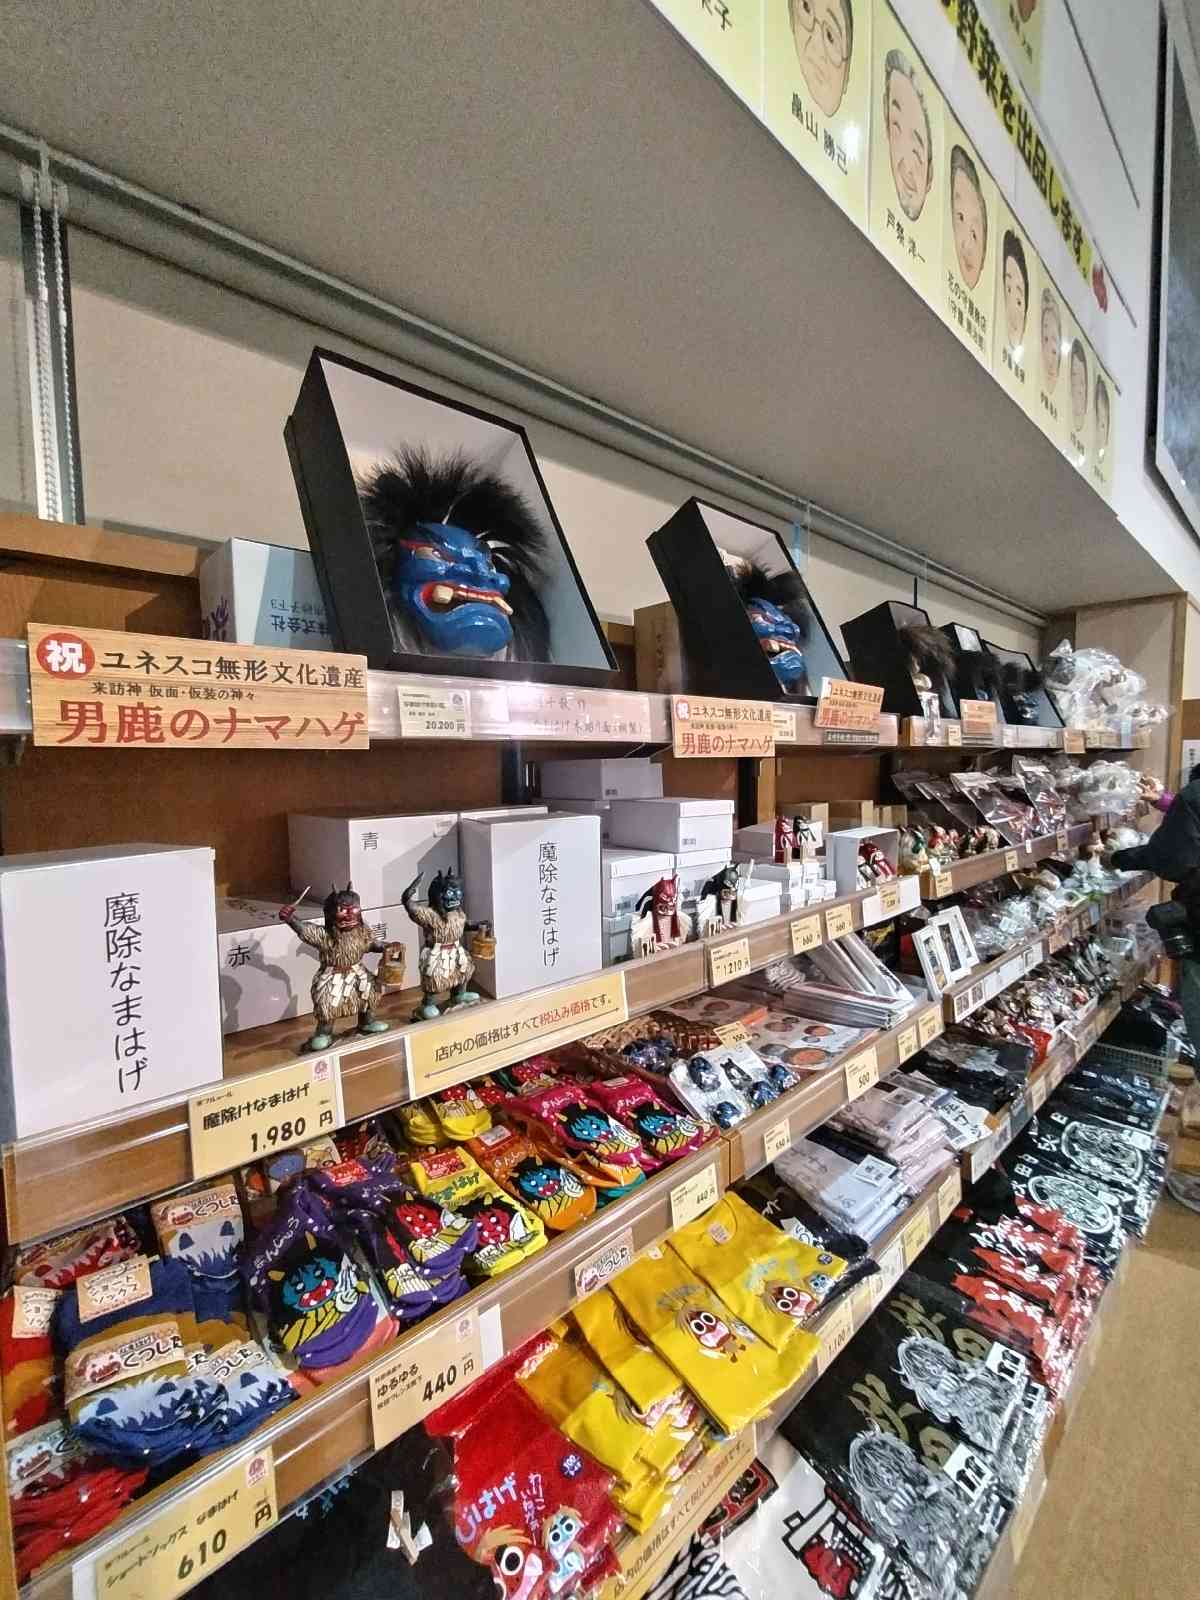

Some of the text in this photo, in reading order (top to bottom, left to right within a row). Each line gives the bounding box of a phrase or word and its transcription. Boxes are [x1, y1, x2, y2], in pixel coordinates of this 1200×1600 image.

[46, 640, 365, 689] 祝 ユネスコ無形文化遺産
[91, 682, 142, 697] 来訪神
[57, 699, 367, 744] 男鹿のナマハゲ
[692, 704, 772, 721] ユネスコ無形文化遺産
[681, 733, 774, 755] 男鹿のナマハゲ
[361, 832, 379, 850] 青
[538, 840, 561, 968] 魔除なまはげ
[228, 944, 251, 968] 赤
[104, 891, 148, 1093] 魔除なまはげ
[434, 993, 612, 1063] 店内の価格はすべて税込み価格です。
[202, 1082, 311, 1131] 魔除けなまはげ
[318, 1109, 334, 1129] 円
[123, 1335, 184, 1369] くつした
[376, 1363, 420, 1398] ゆるゆる
[421, 1363, 458, 1402] 440
[462, 1357, 475, 1375] 円
[176, 1528, 228, 1581] 610
[254, 1502, 274, 1529] 円
